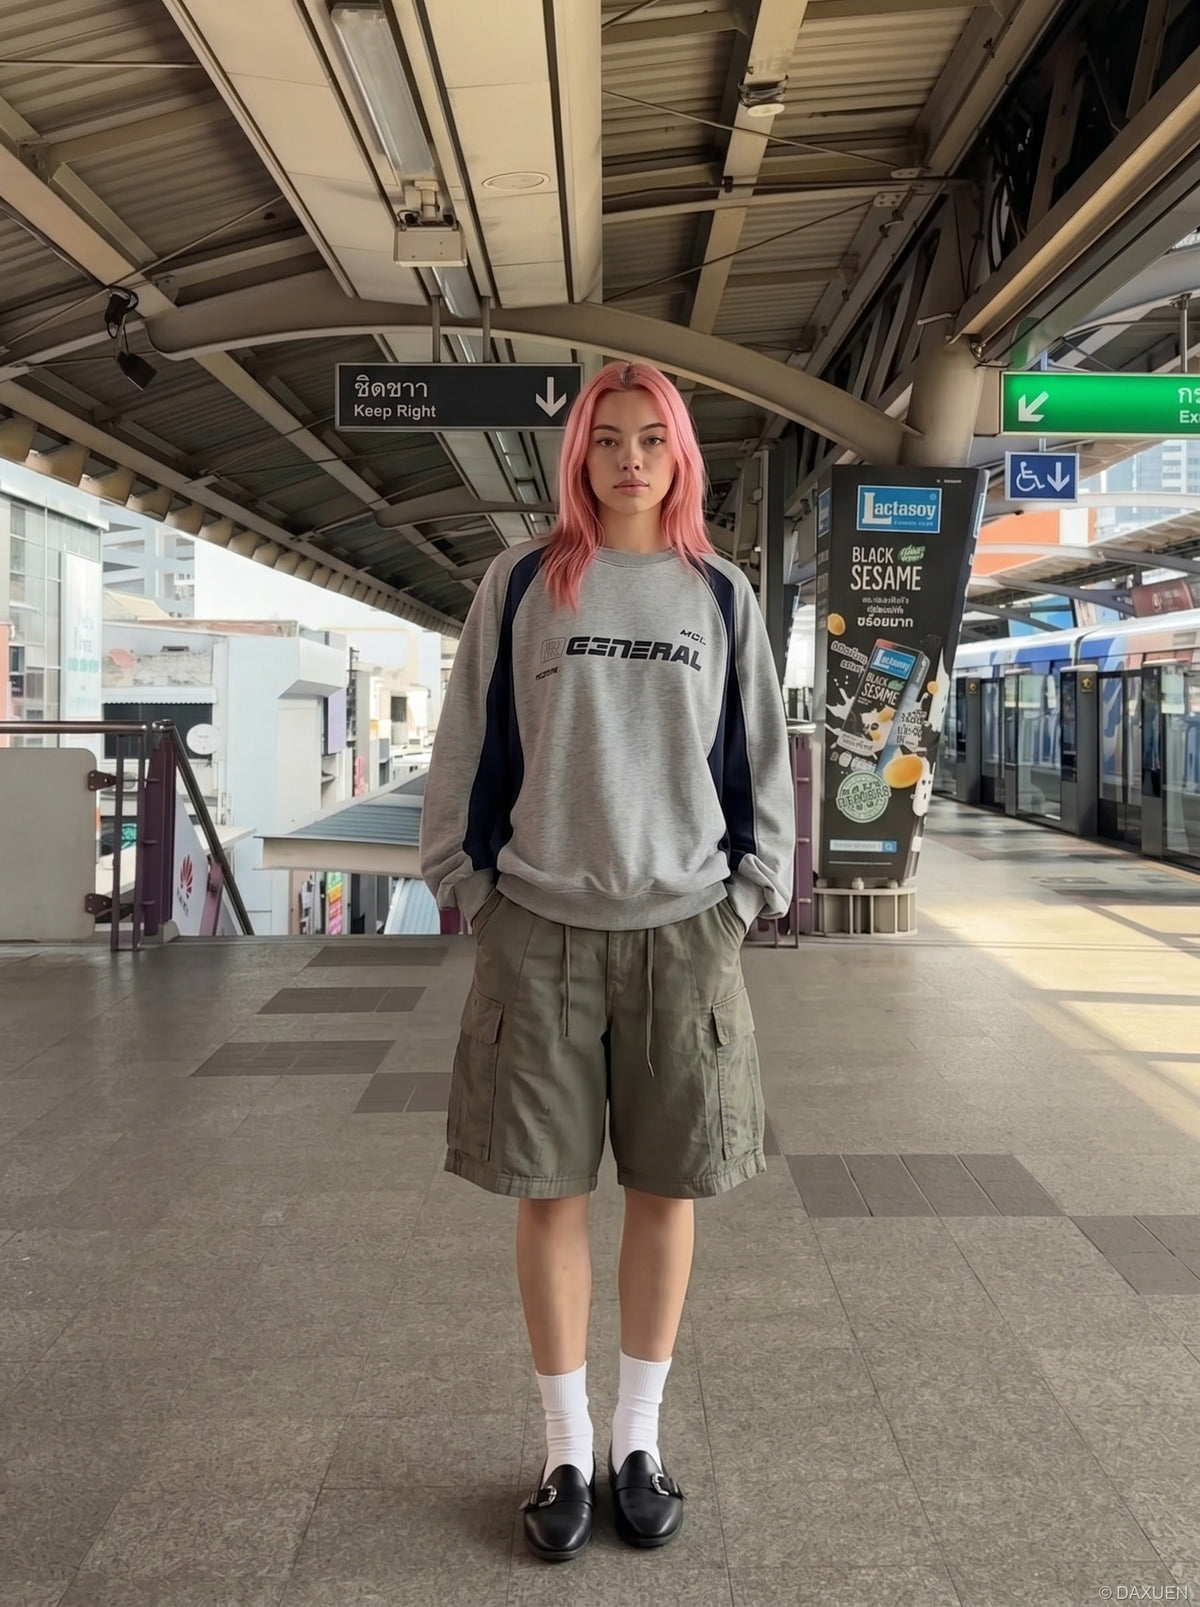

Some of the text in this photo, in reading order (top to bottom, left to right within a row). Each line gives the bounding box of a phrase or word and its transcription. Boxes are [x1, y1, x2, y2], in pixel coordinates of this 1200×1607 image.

[354, 404, 437, 421] Keep Right
[1179, 410, 1200, 424] Ex
[862, 492, 937, 525] Lactasoy
[852, 546, 895, 564] BLACK
[850, 564, 923, 591] SESAME
[565, 636, 702, 672] GENERAL
[865, 671, 889, 687] BLACK
[861, 682, 900, 706] SESAME
